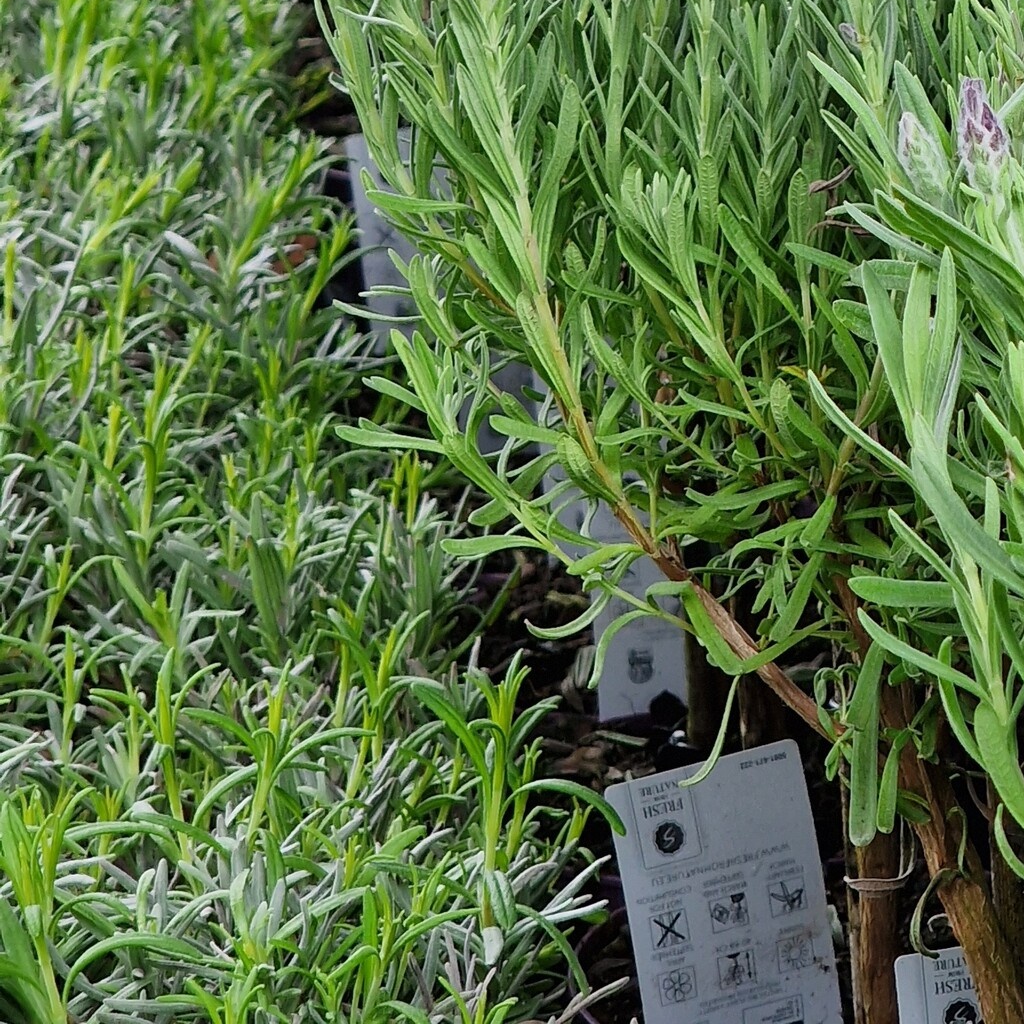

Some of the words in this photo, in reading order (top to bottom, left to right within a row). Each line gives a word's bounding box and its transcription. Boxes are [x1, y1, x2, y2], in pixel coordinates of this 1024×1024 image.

[639, 780, 680, 798] NATURE
[642, 798, 684, 820] FRESH
[720, 881, 747, 895] MARCH
